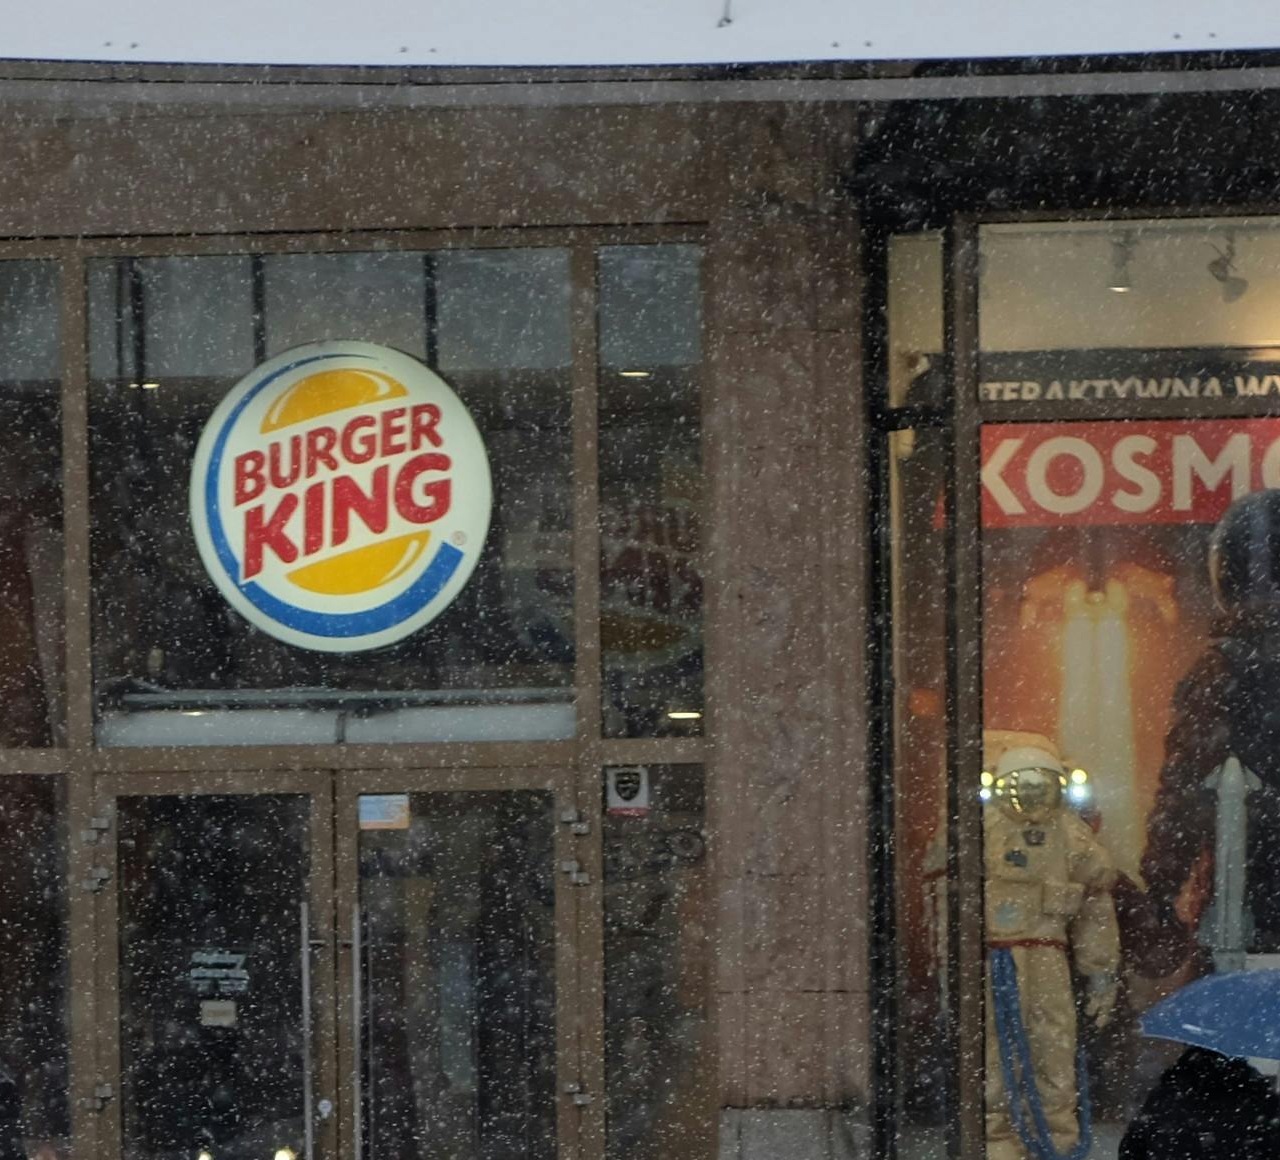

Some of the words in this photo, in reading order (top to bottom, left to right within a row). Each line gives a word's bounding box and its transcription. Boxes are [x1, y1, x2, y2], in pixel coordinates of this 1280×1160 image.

[979, 373, 1222, 401] TERAKTYWNA
[234, 402, 443, 507] BURGER
[243, 452, 453, 580] KING
